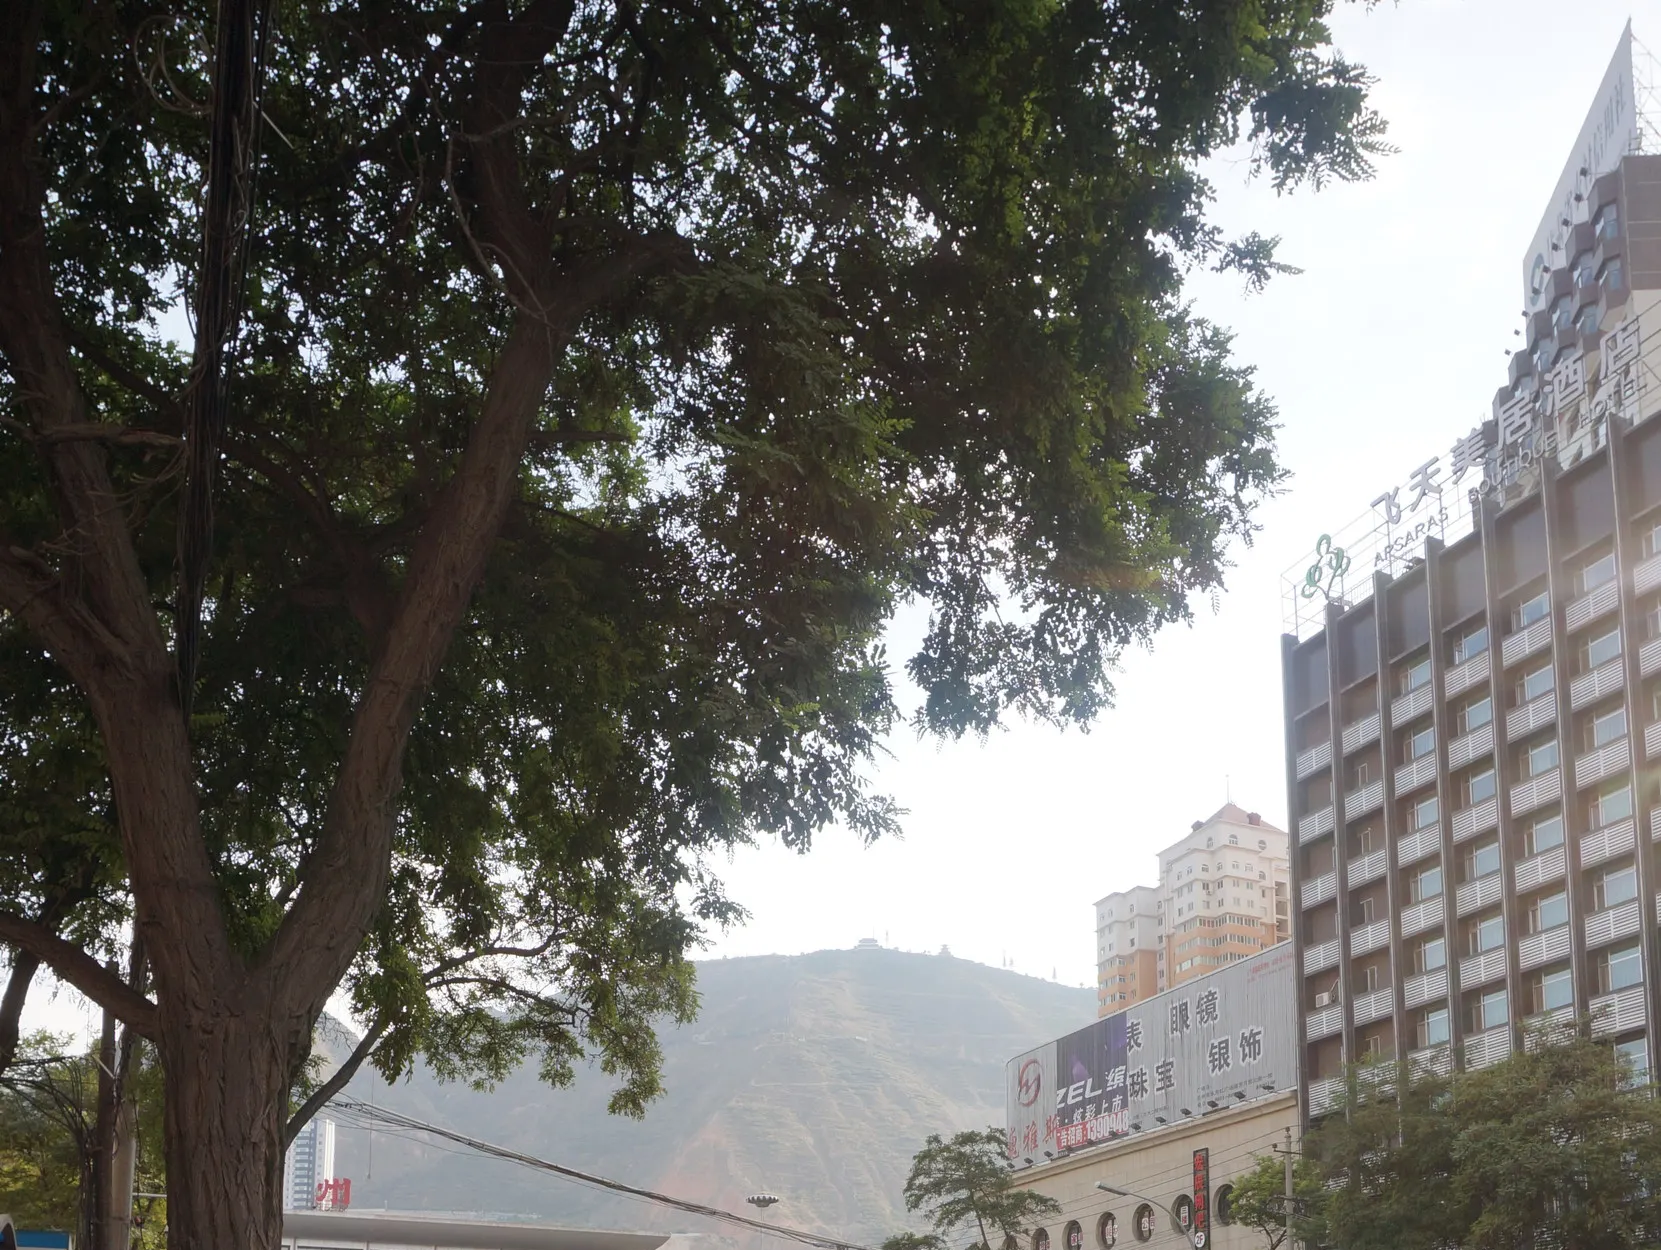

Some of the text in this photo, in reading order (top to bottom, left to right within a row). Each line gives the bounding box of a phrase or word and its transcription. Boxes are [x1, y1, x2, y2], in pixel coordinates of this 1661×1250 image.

[1370, 320, 1641, 525] 飞天美居酒店
[1374, 506, 1449, 567] APSARAS
[1468, 431, 1558, 504] BOUTIQUE
[1170, 989, 1218, 1035] 眼镜
[1128, 1060, 1175, 1099] 珠宝
[1208, 1028, 1262, 1074] 银饰
[316, 1178, 351, 1206] 州
